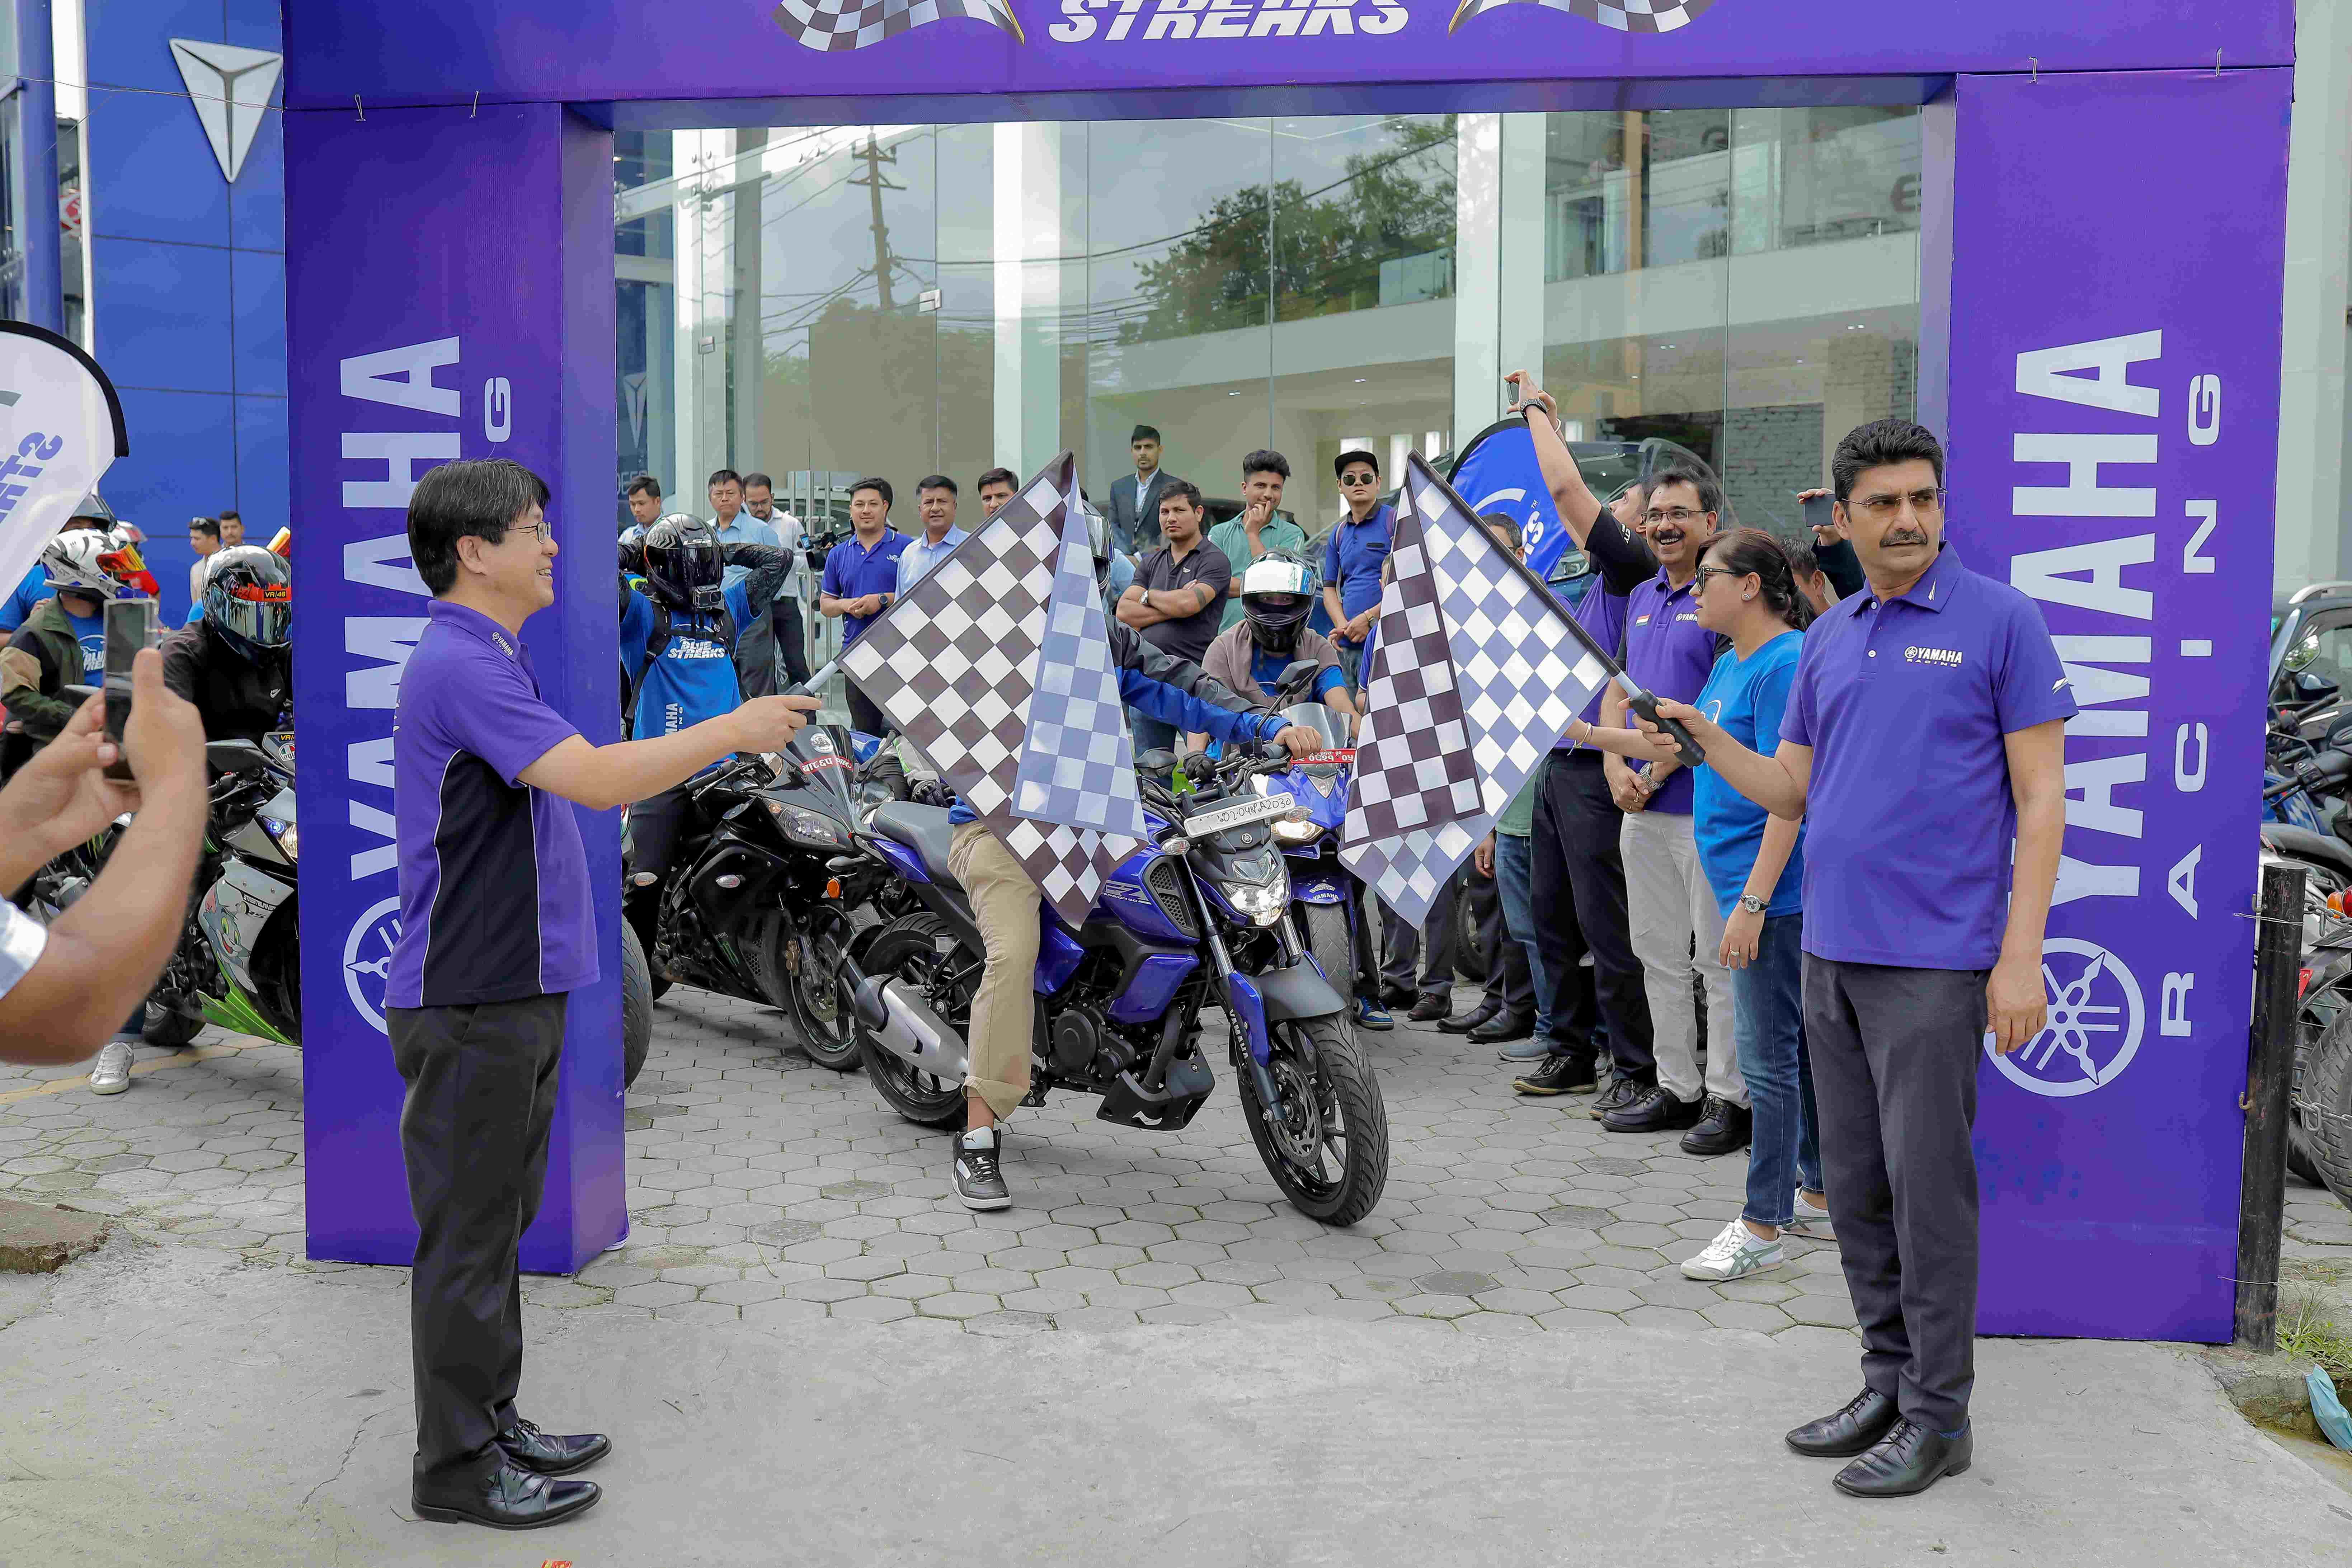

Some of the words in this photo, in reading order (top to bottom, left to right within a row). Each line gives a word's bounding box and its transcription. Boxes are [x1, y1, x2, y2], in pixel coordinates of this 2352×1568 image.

[1681, 613, 1698, 621] YAMA
[497, 636, 513, 655] YAMAHA
[681, 640, 712, 650] BLUE
[667, 647, 725, 659] STREAKS
[1918, 647, 1963, 663] YAMAHA
[1906, 659, 1958, 668] RACING
[2160, 373, 2221, 1037] RACING
[665, 703, 678, 735] AHA
[1313, 893, 1339, 902] YAMAHA
[1229, 1008, 1249, 1059] YAMAHA
